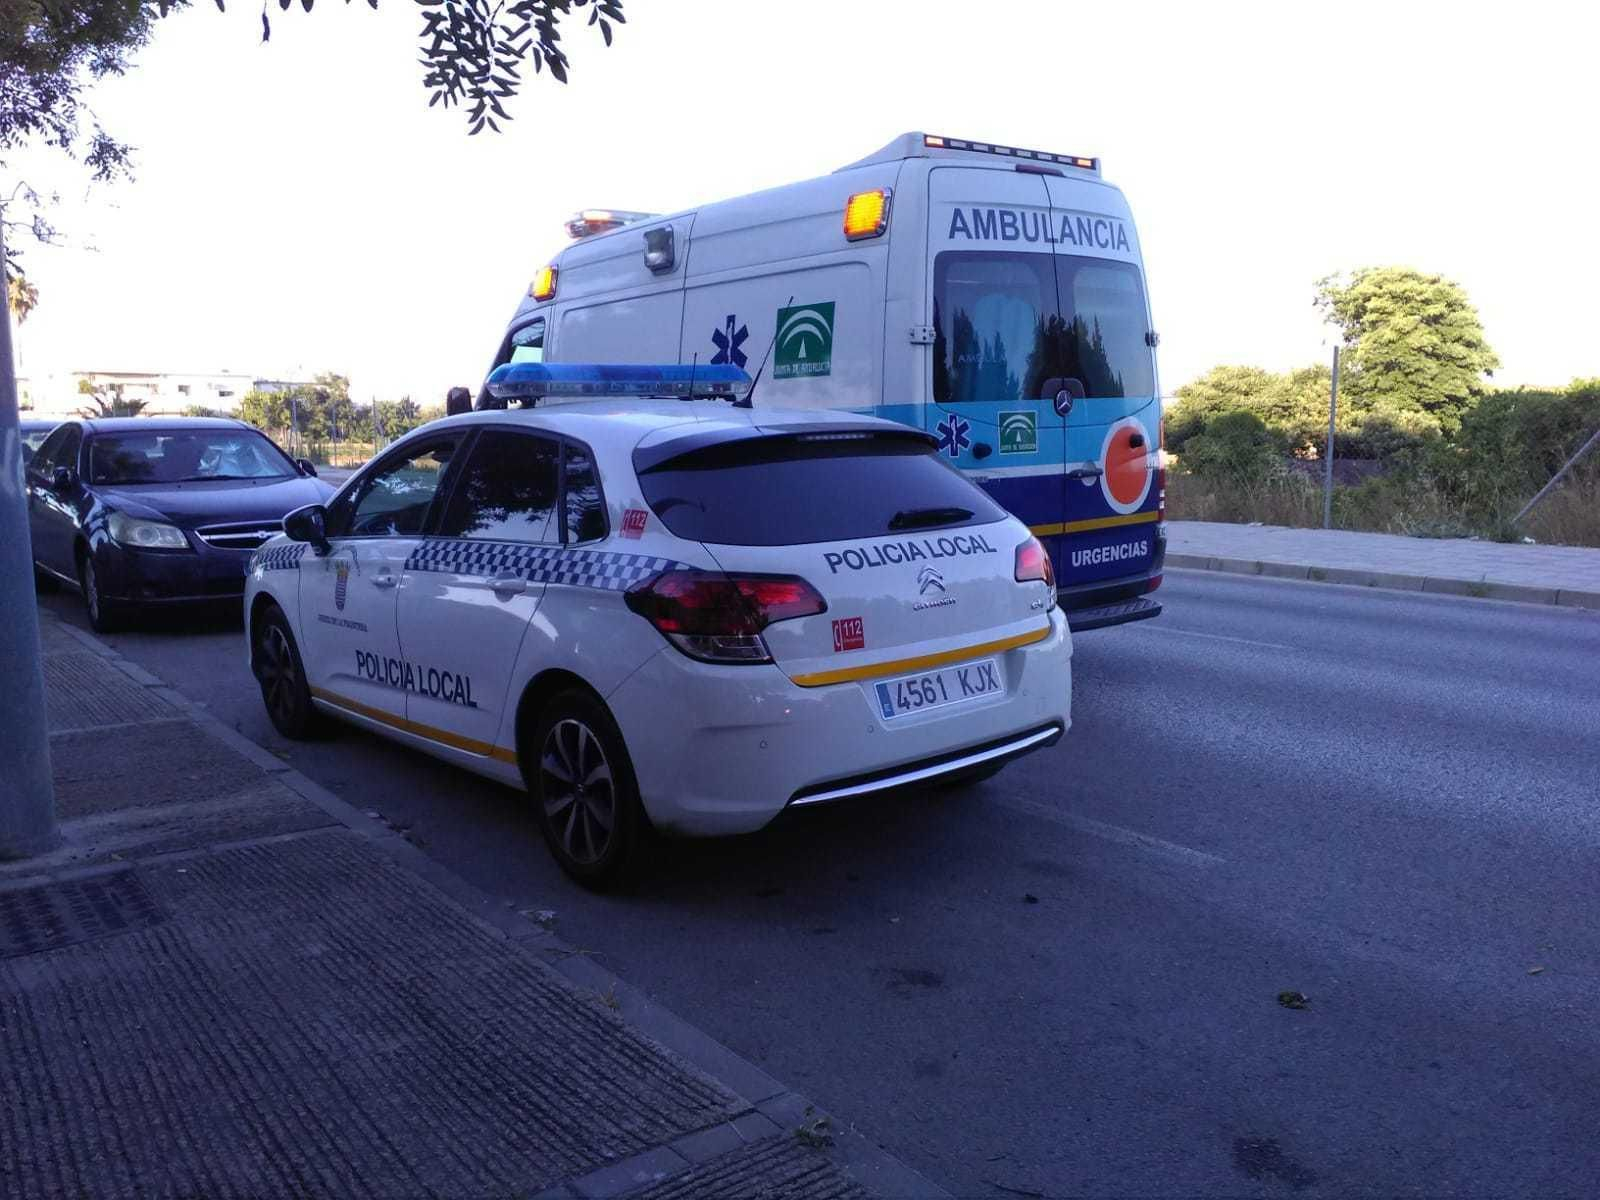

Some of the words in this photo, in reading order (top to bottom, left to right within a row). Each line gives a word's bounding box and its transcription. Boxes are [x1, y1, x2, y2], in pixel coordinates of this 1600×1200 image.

[949, 207, 1130, 252] AMBULANCIA
[630, 511, 647, 528] 112
[824, 541, 927, 574] POLICIA
[923, 534, 998, 559] LOCAL
[1071, 540, 1148, 567] URGENCIAS
[843, 619, 862, 637] 112
[355, 650, 415, 692] POLICIA
[418, 665, 478, 708] LOCAL
[896, 674, 948, 709] 4561
[957, 663, 998, 696] KJX
